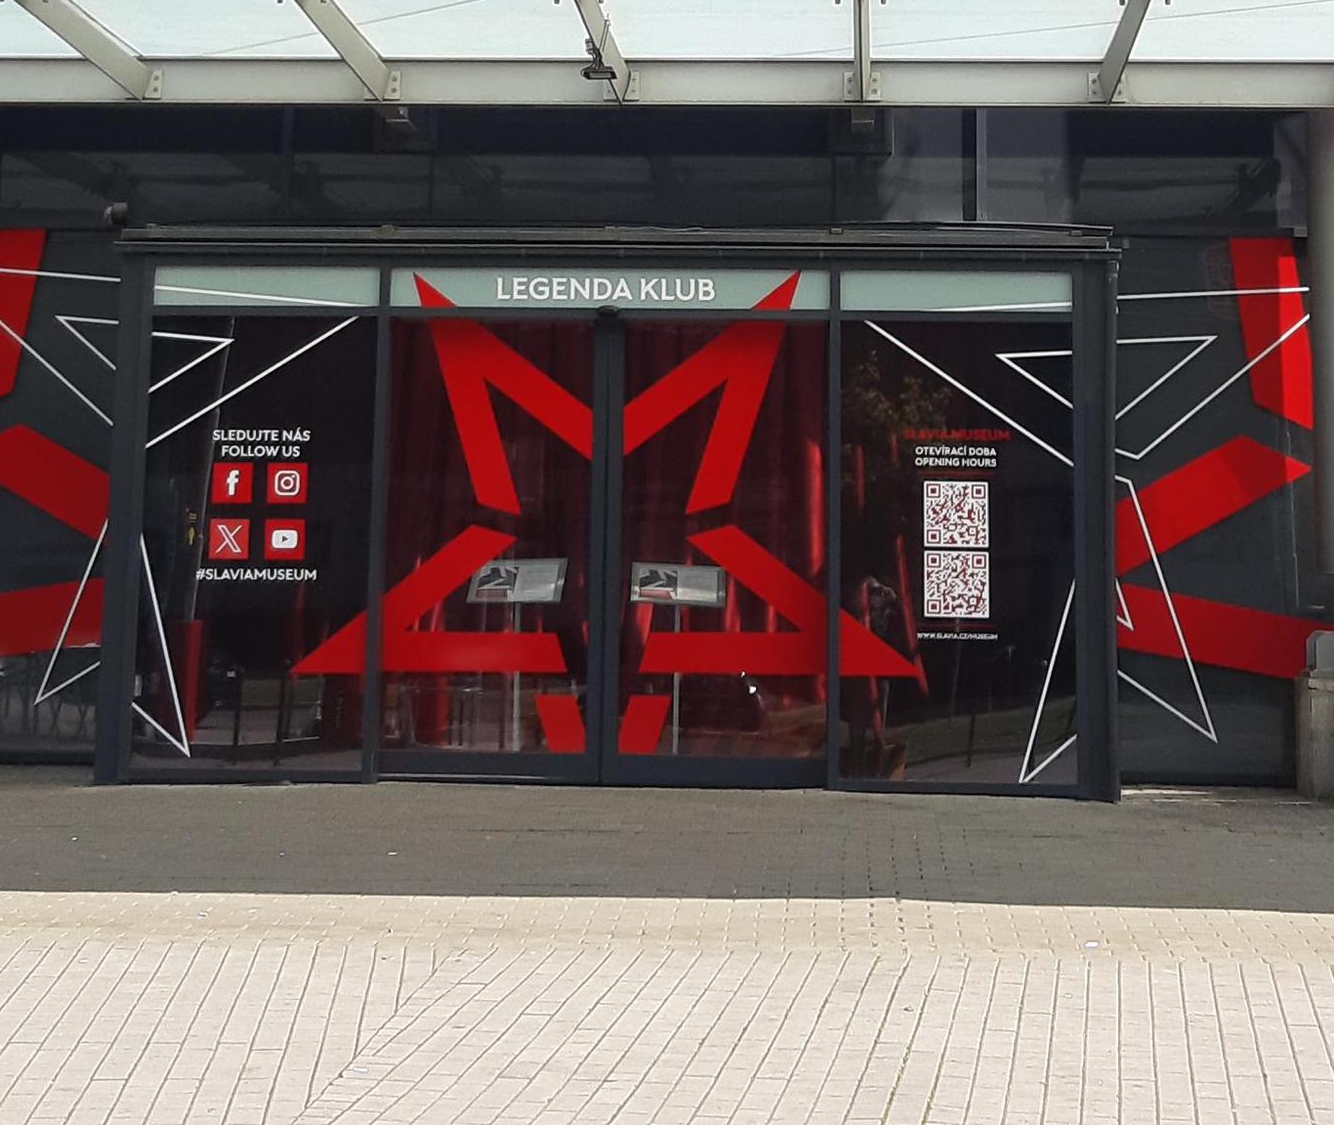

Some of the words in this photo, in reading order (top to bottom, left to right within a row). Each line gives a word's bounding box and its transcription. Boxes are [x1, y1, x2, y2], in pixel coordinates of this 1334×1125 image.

[497, 277, 632, 301] LEGENDA
[640, 278, 715, 301] KLUB
[212, 429, 280, 442] SLEDUJTE
[282, 427, 311, 442] NÁS
[221, 445, 280, 457] FOLLOW
[282, 445, 301, 457] US
[915, 443, 967, 456] OTEVÍRACÍ
[969, 446, 997, 456] DOBA
[915, 457, 959, 467] OPENING
[961, 458, 997, 467] HOURS
[195, 568, 317, 581] #SLAVIAMUSEUM
